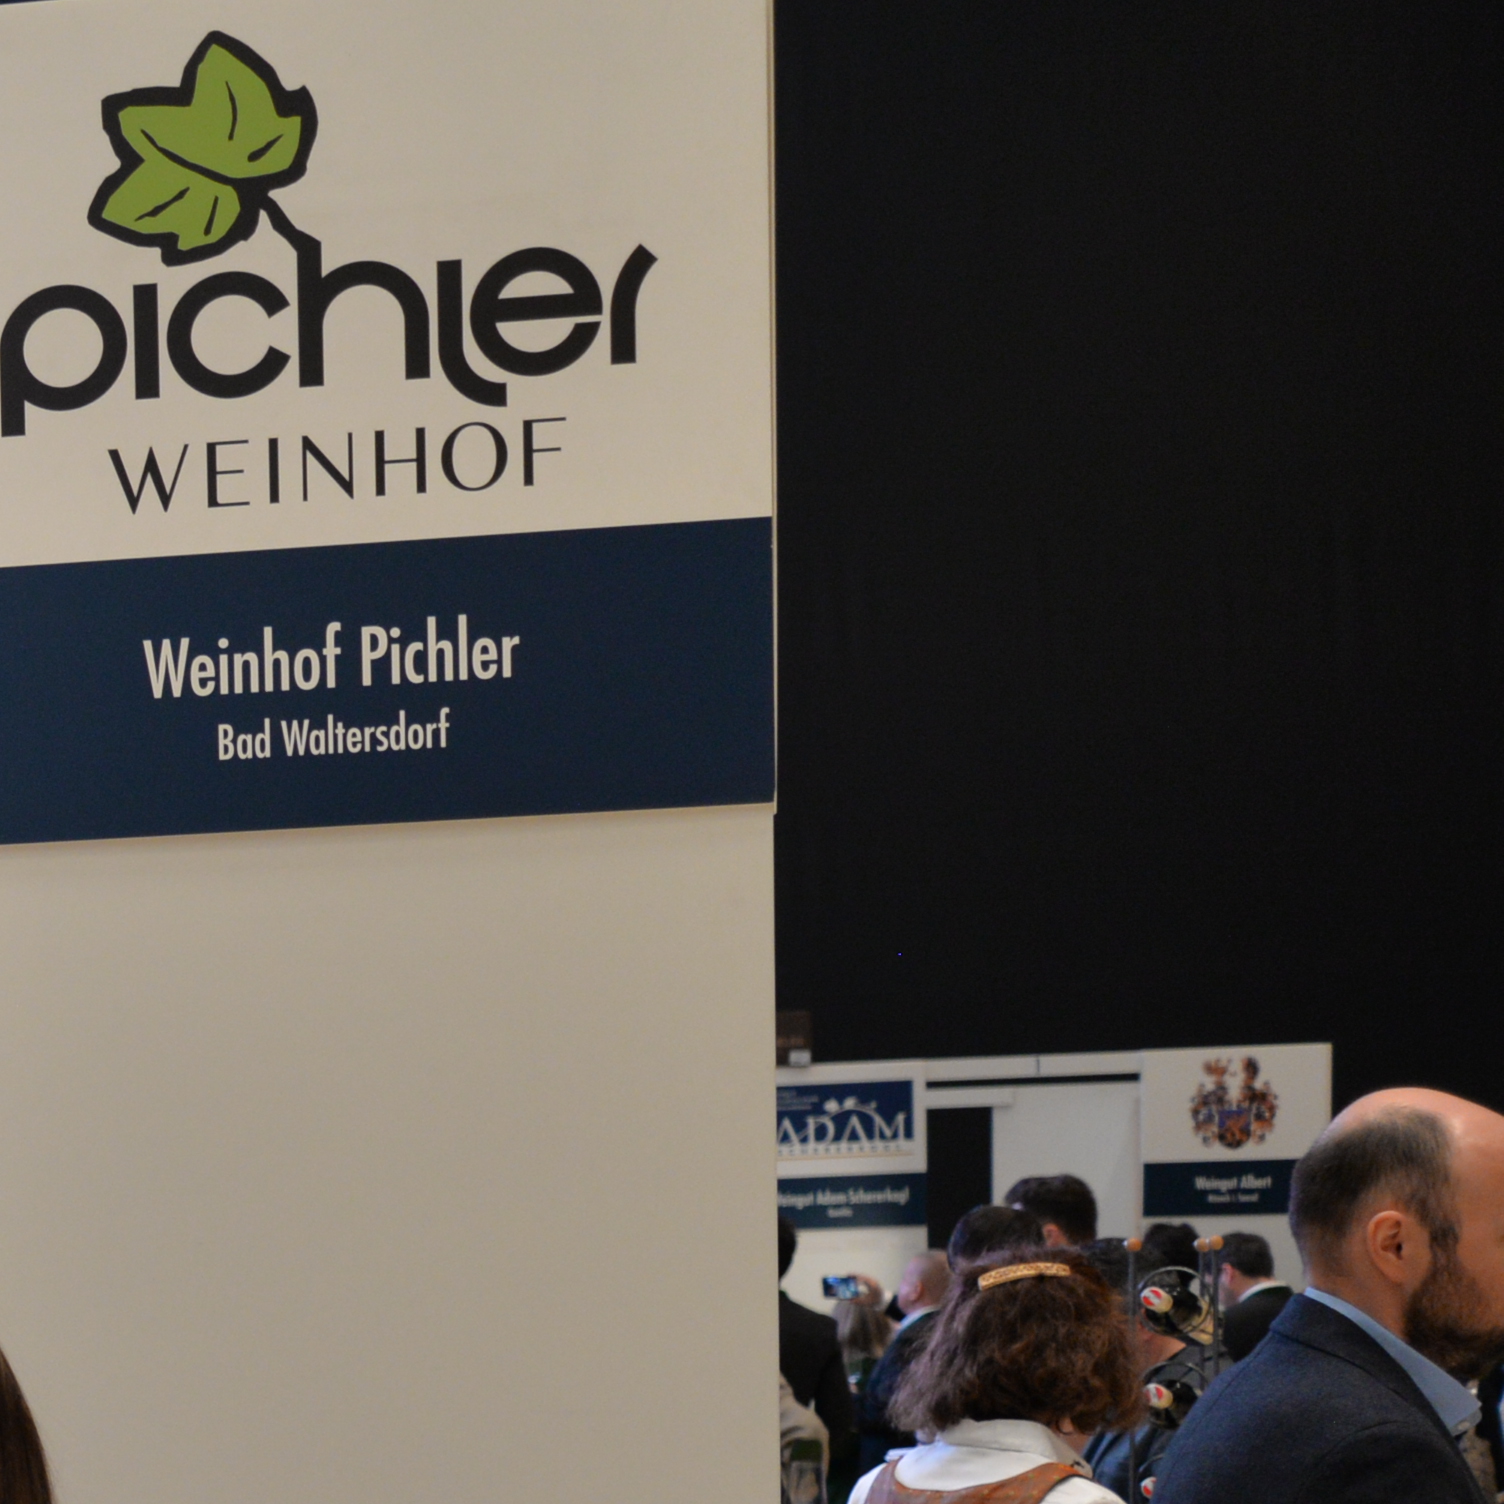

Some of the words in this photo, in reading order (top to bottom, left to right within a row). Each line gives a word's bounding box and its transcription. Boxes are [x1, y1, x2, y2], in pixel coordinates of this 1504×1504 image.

[108, 416, 567, 514] WEINHOF
[142, 623, 341, 699] Weinhof
[361, 615, 521, 686] Pichler
[217, 720, 272, 761] Bad
[280, 709, 451, 757] Waltersdorf
